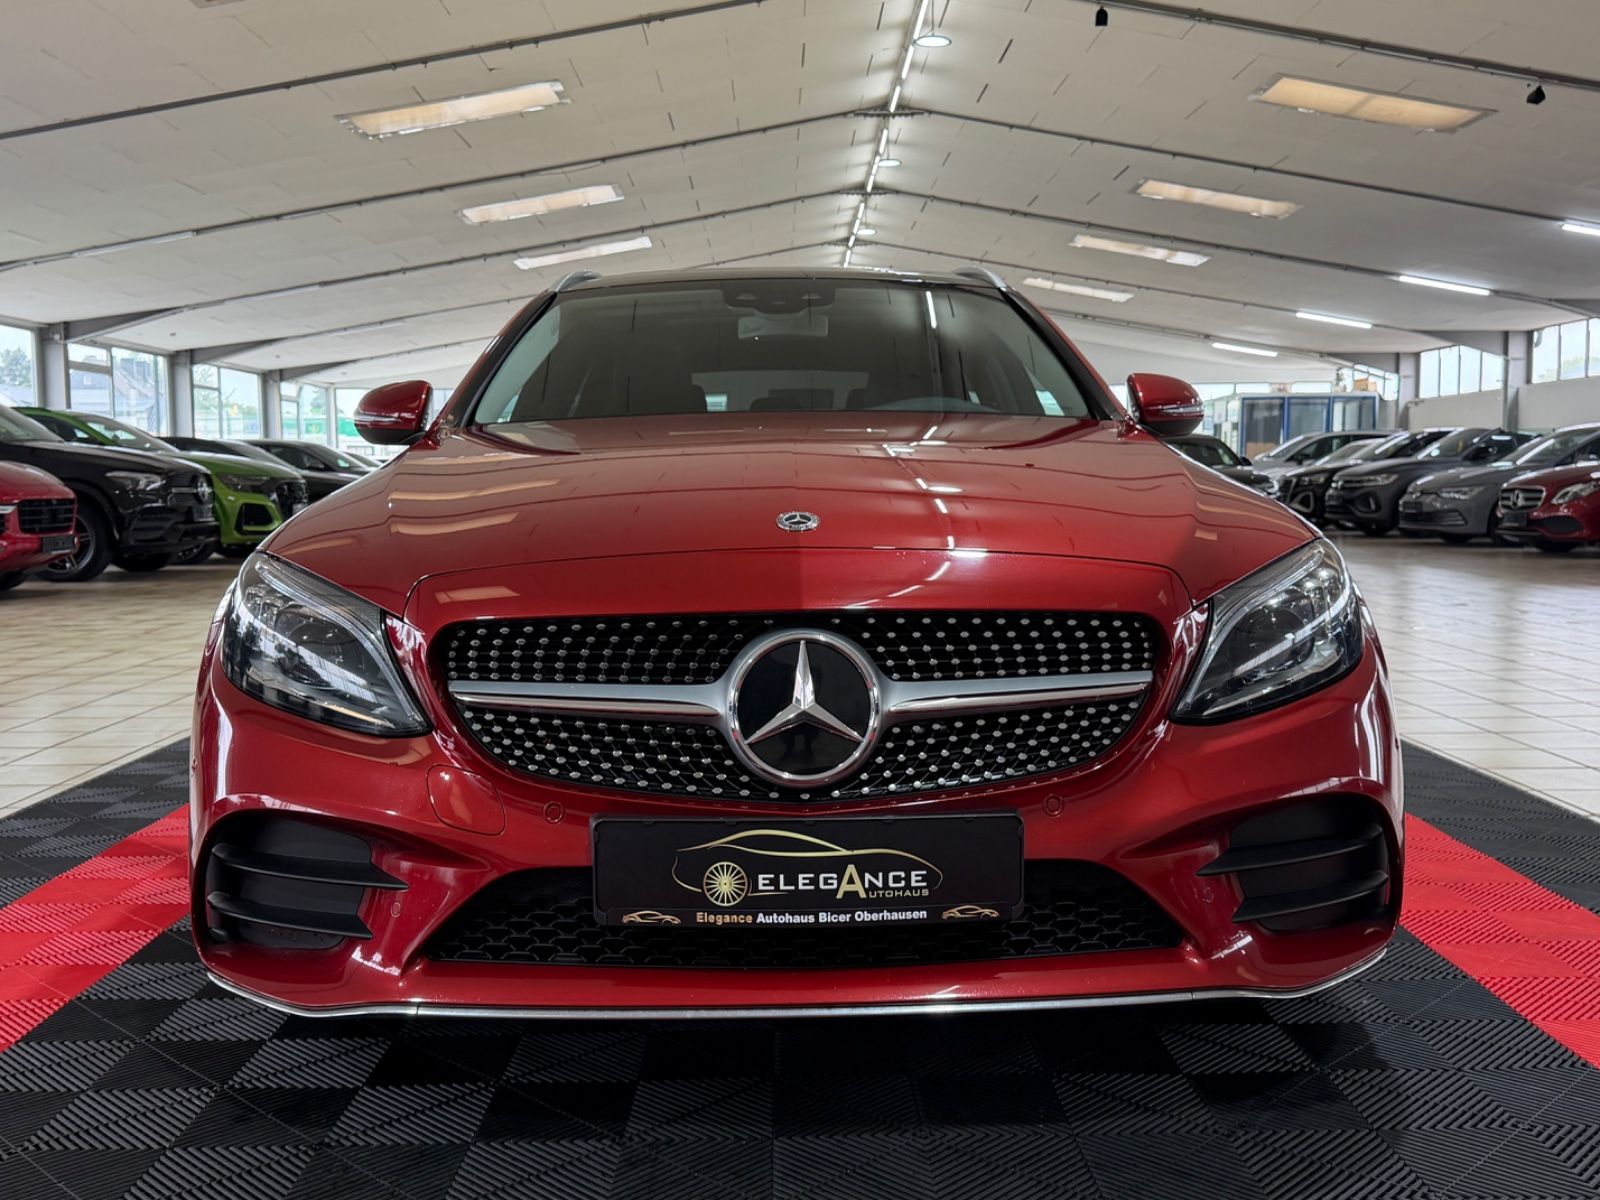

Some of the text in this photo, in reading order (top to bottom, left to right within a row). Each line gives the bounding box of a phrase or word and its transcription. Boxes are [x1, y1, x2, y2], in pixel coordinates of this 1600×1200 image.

[758, 864, 928, 899] ELEGANCE
[696, 909, 927, 926] Elegance Autohaus Bicer Oberhausen
